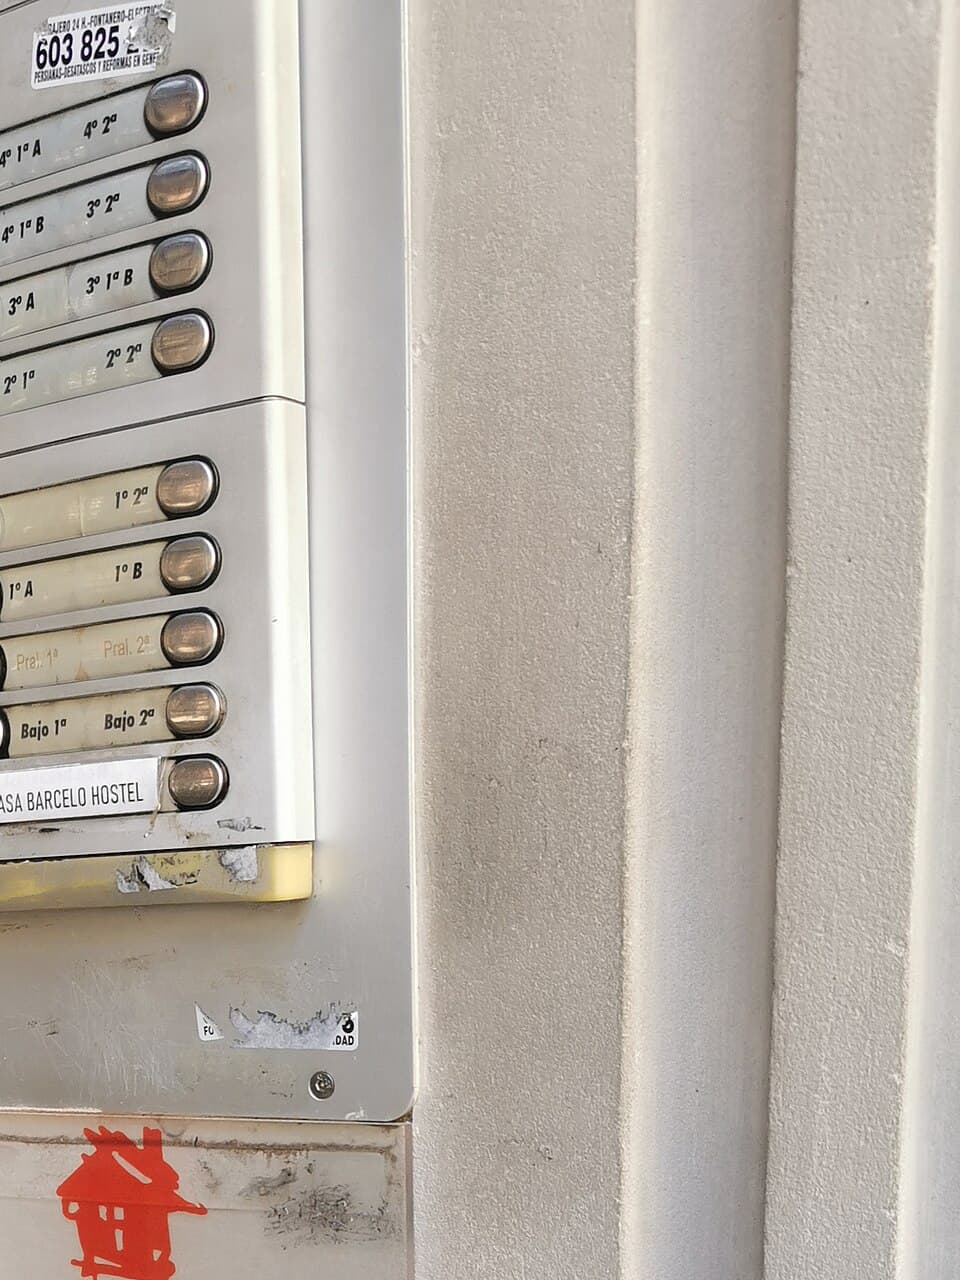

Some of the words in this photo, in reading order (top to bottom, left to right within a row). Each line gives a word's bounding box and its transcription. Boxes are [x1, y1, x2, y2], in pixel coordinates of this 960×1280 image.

[72, 18, 81, 31] 24
[36, 33, 73, 70] 603
[80, 25, 120, 62] 825
[97, 62, 103, 73] Y
[103, 56, 132, 72] REFORMAS
[133, 54, 142, 67] EN
[32, 139, 41, 157] A
[35, 216, 45, 234] B
[123, 268, 133, 286] B
[26, 292, 35, 311] A
[133, 562, 143, 580] B
[24, 580, 33, 598] A
[104, 637, 132, 657] Pral.
[21, 720, 49, 741] Bajo
[104, 710, 135, 732] Bajo
[27, 786, 86, 811] BARCELO
[91, 781, 144, 806] HOSTEL
